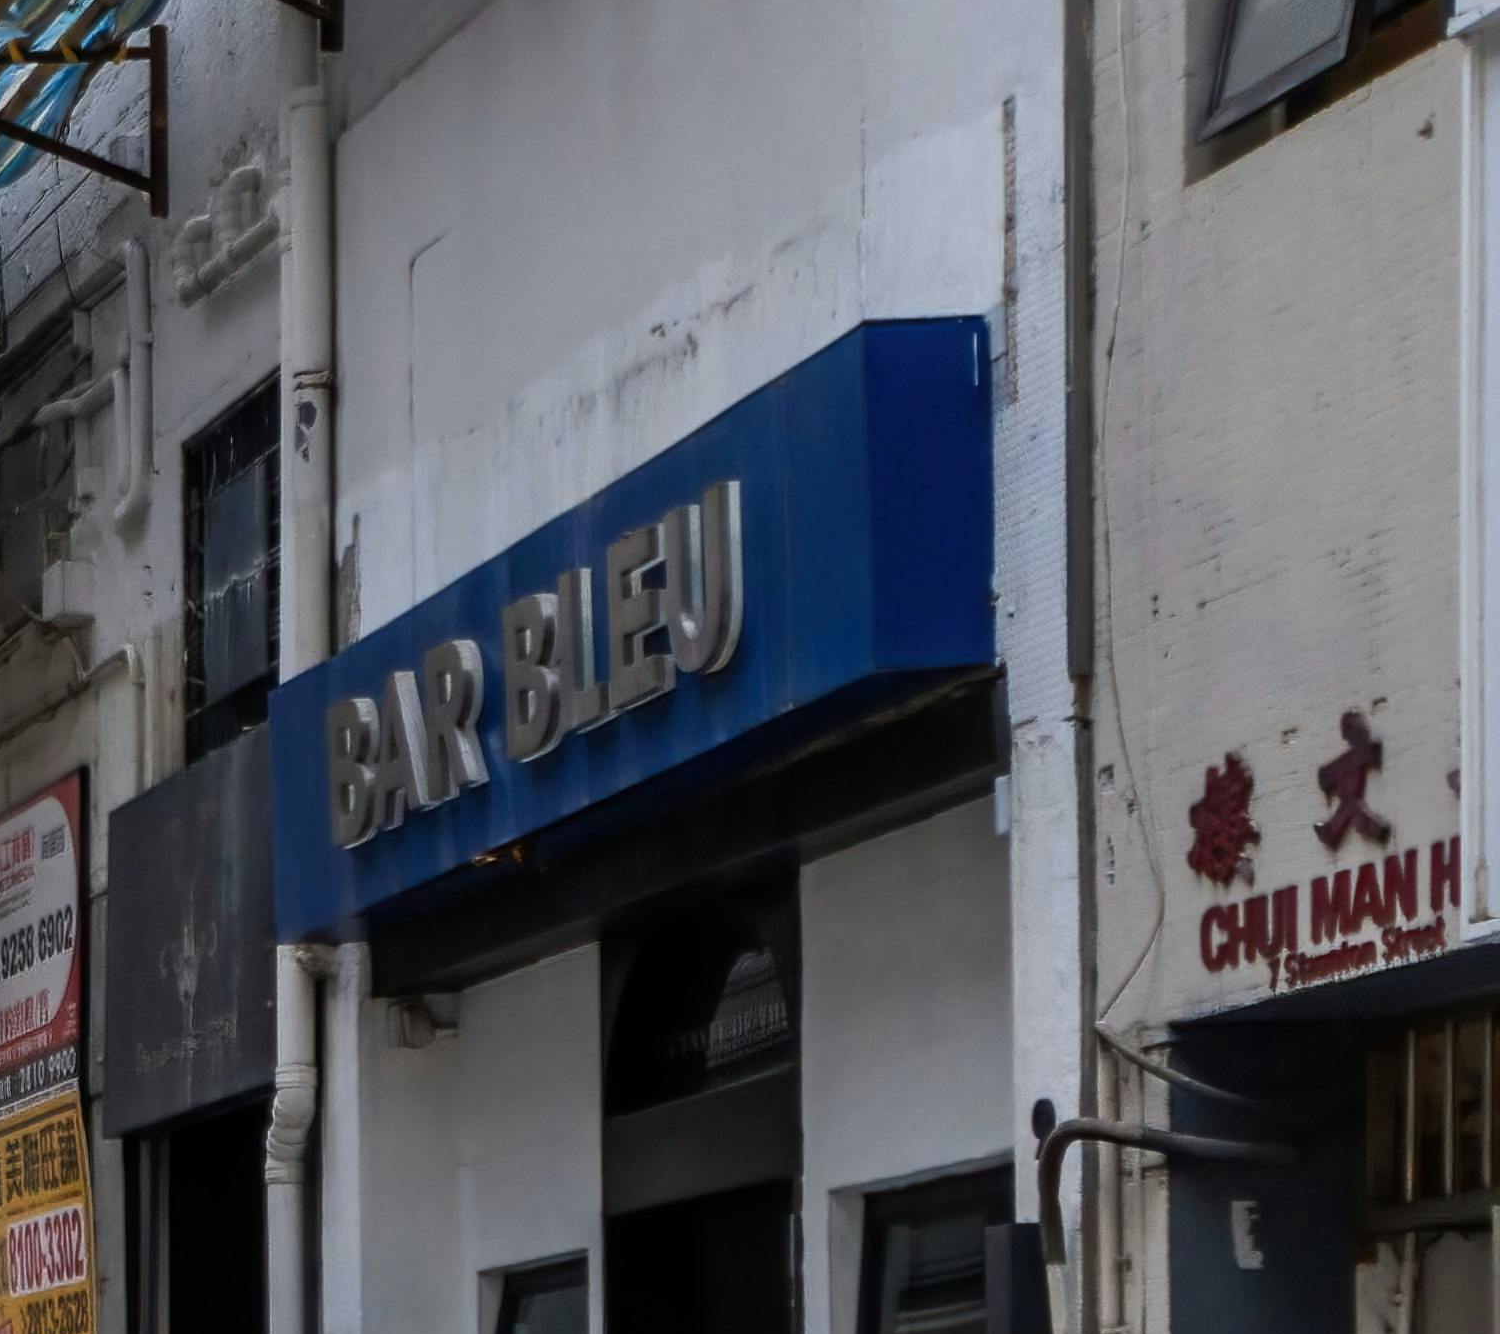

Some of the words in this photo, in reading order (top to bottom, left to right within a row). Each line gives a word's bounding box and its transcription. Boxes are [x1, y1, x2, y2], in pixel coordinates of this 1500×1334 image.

[328, 638, 491, 851] BAR
[504, 481, 745, 764] BLEU
[1, 924, 35, 980] 9258
[39, 903, 74, 963] 6902
[1200, 885, 1299, 975] CHUI
[1311, 848, 1419, 946] MAN
